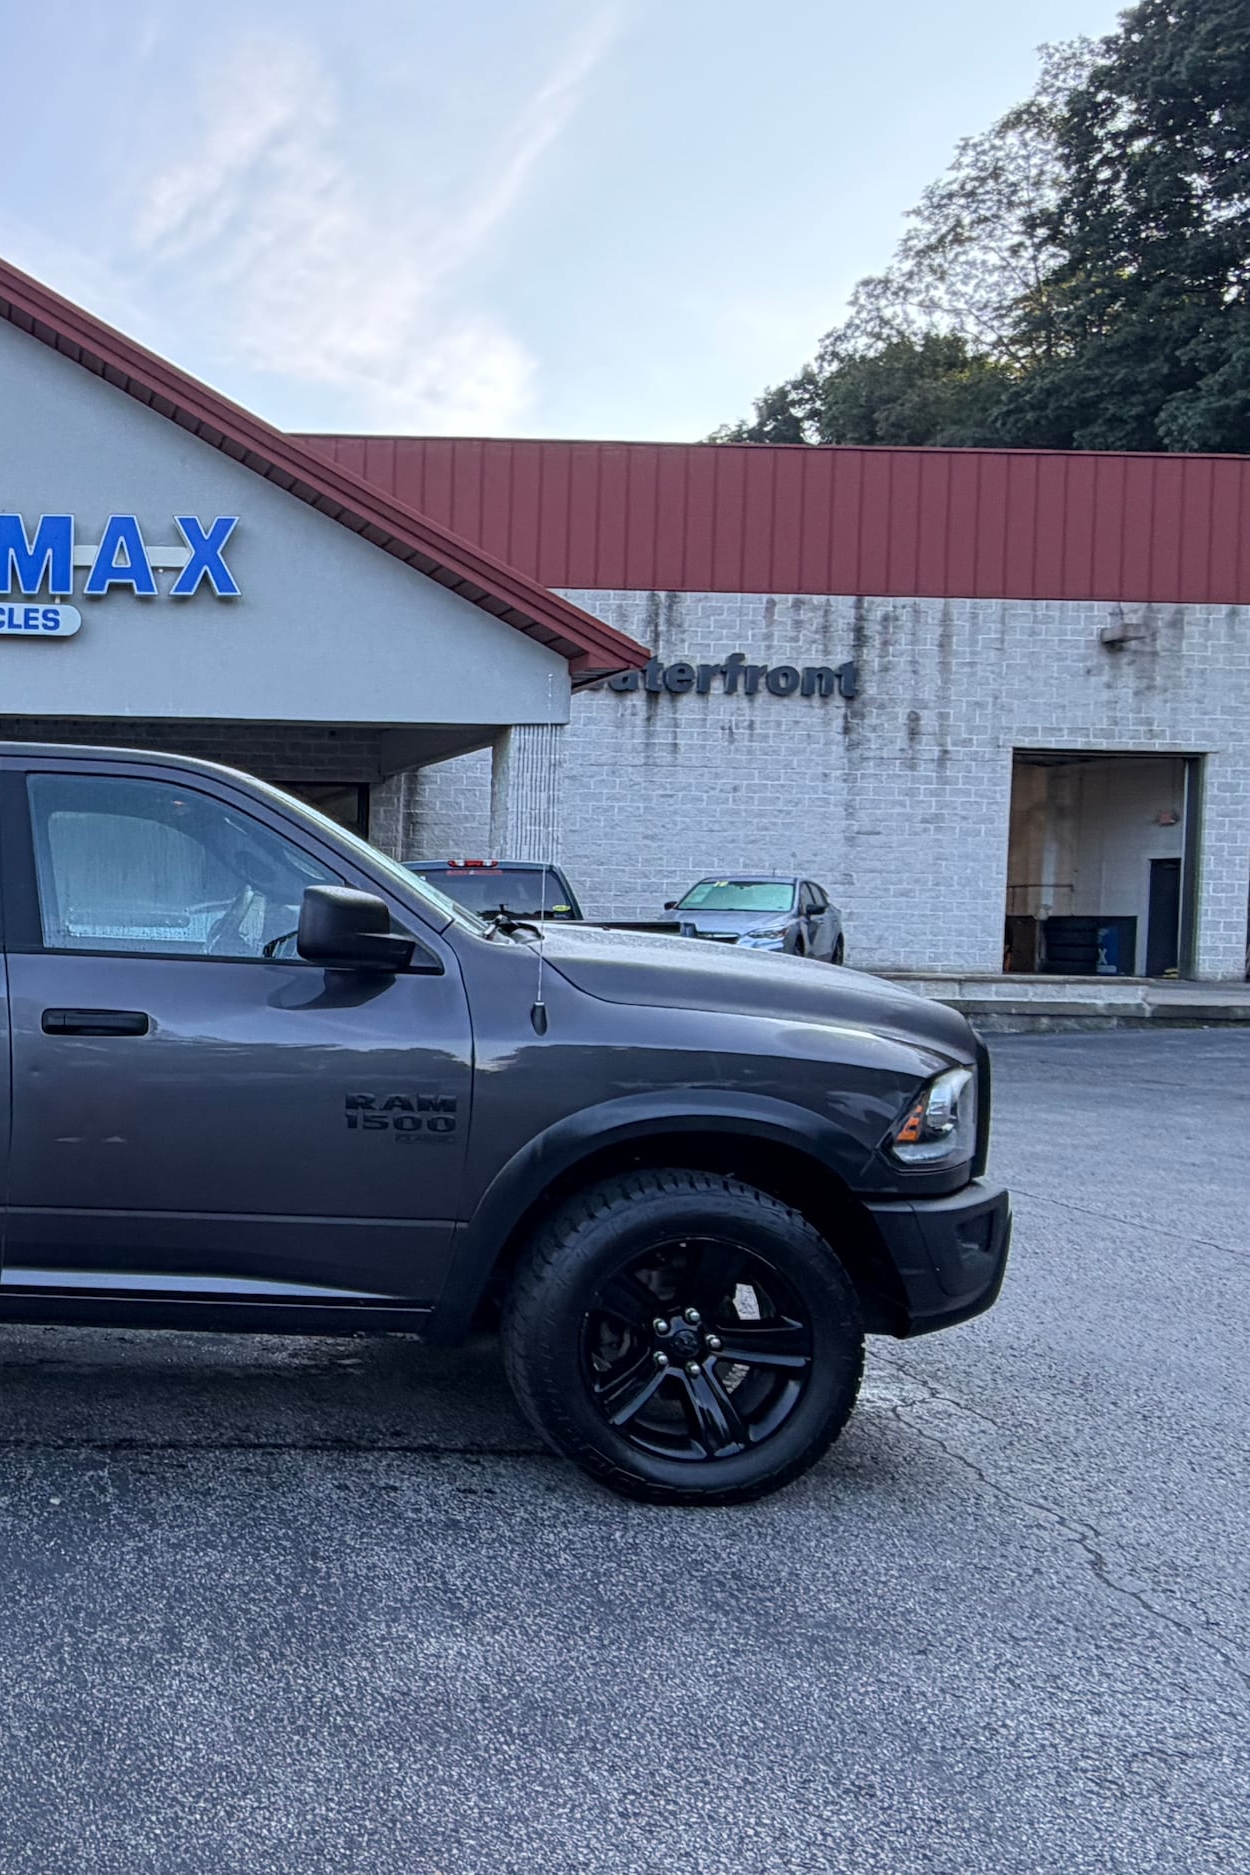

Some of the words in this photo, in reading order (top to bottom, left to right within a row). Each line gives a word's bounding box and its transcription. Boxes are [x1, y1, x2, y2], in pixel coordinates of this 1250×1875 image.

[592, 652, 860, 698] aterfront
[345, 1093, 457, 1113] RAM
[345, 1112, 456, 1132] 1500
